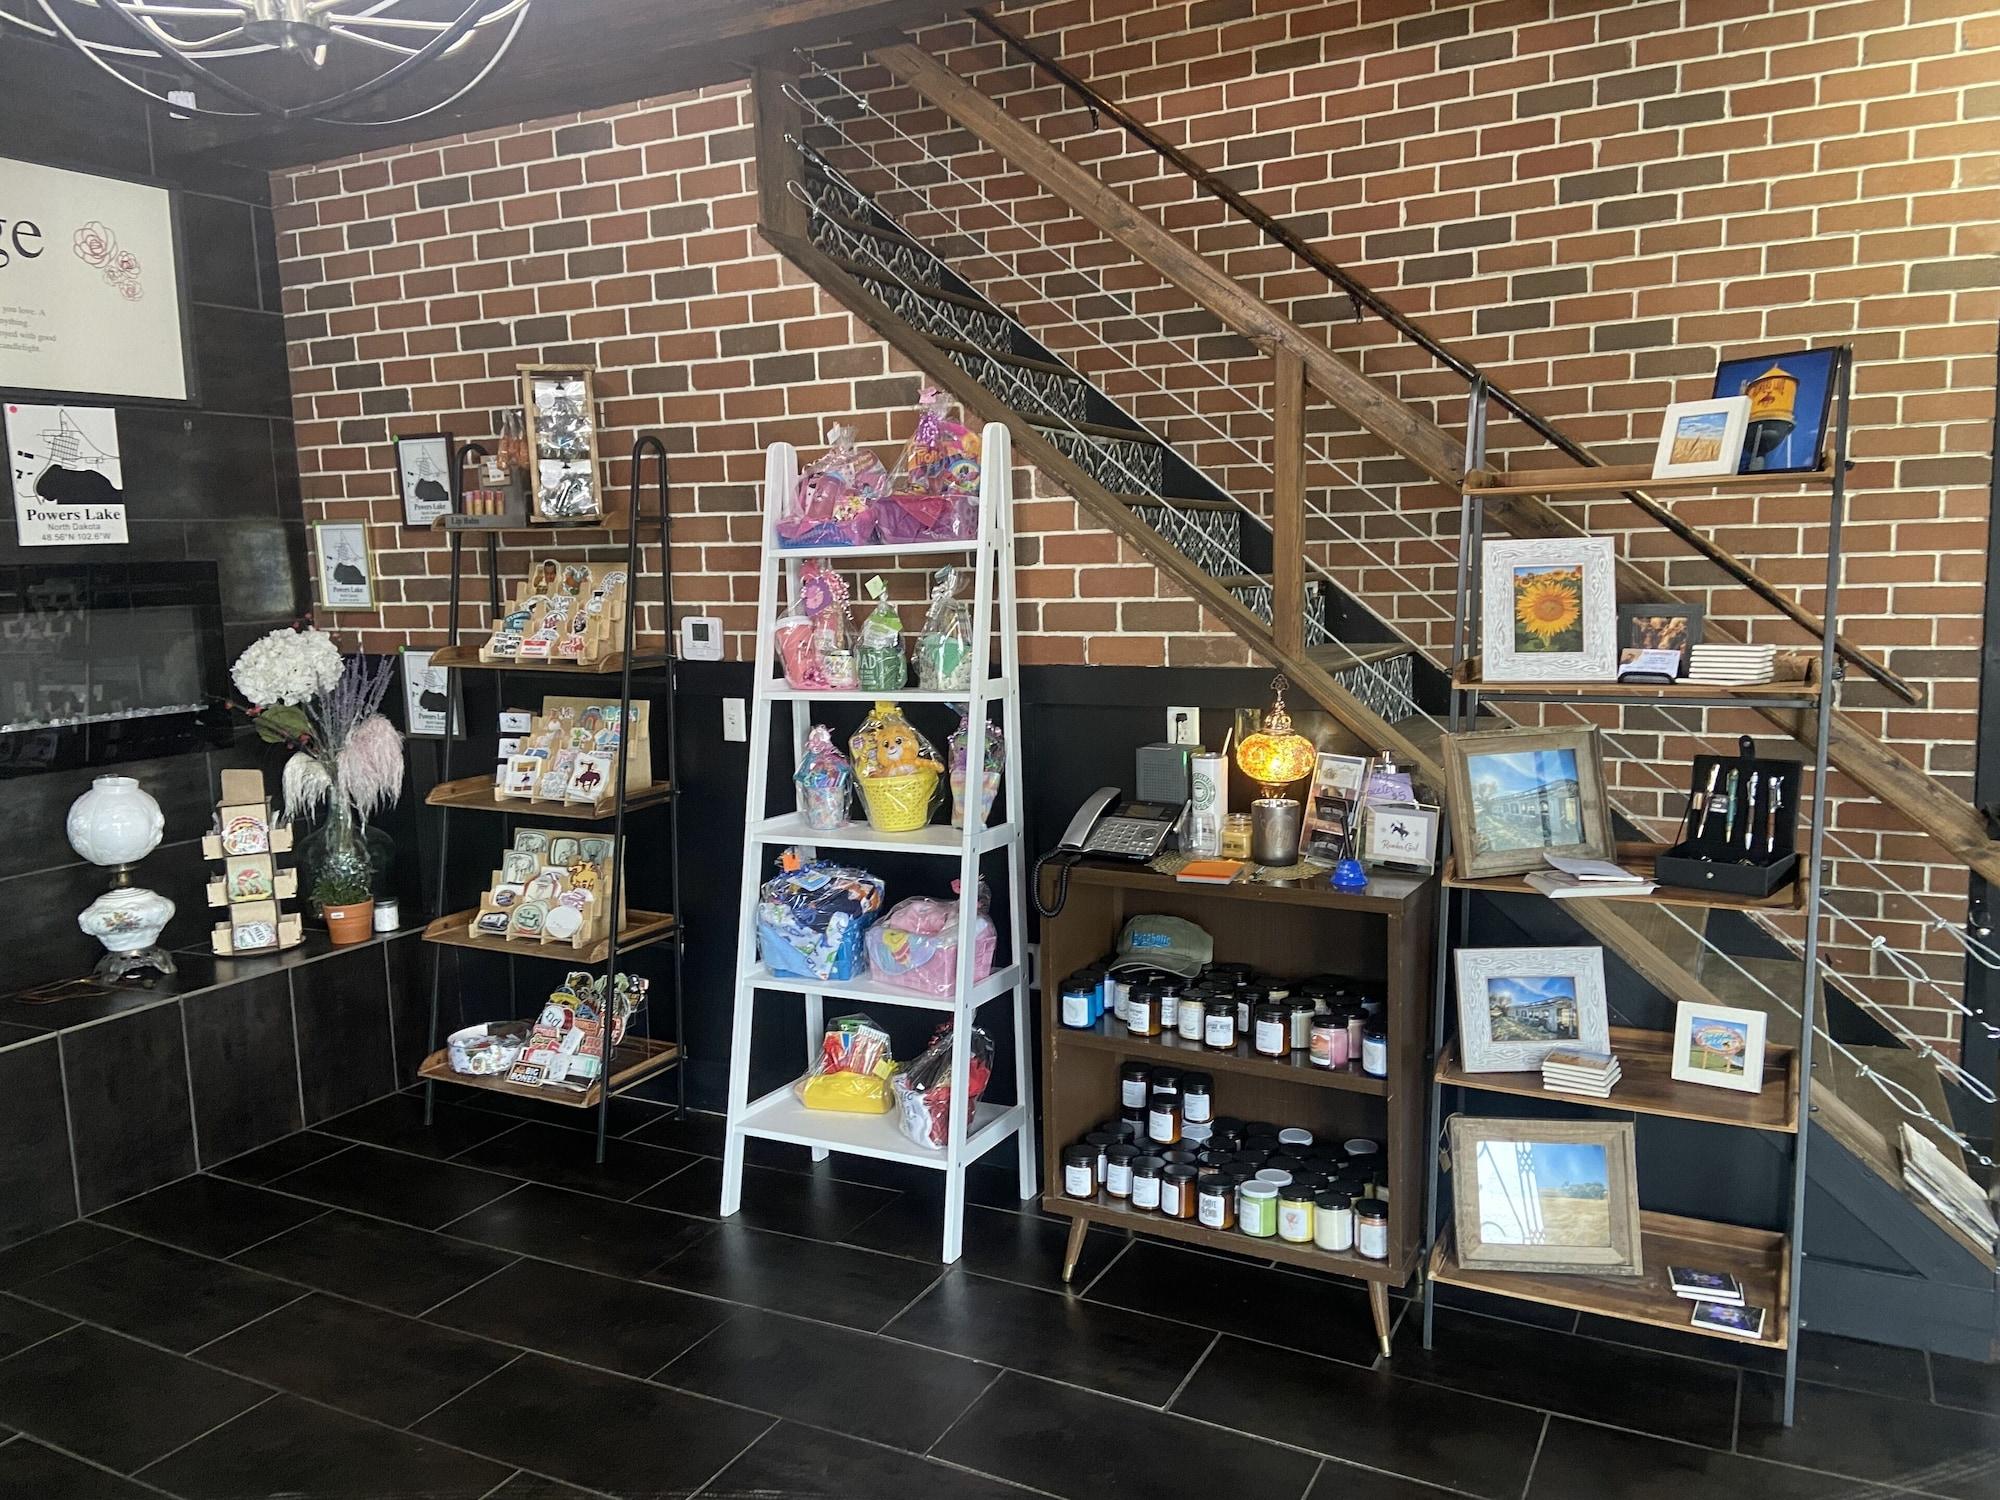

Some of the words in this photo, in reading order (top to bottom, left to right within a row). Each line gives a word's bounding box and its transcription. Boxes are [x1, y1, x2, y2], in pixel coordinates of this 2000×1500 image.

[26, 509, 80, 521] Powers
[85, 508, 121, 520] Lake
[48, 523, 71, 531] North
[73, 522, 102, 530] Dakota
